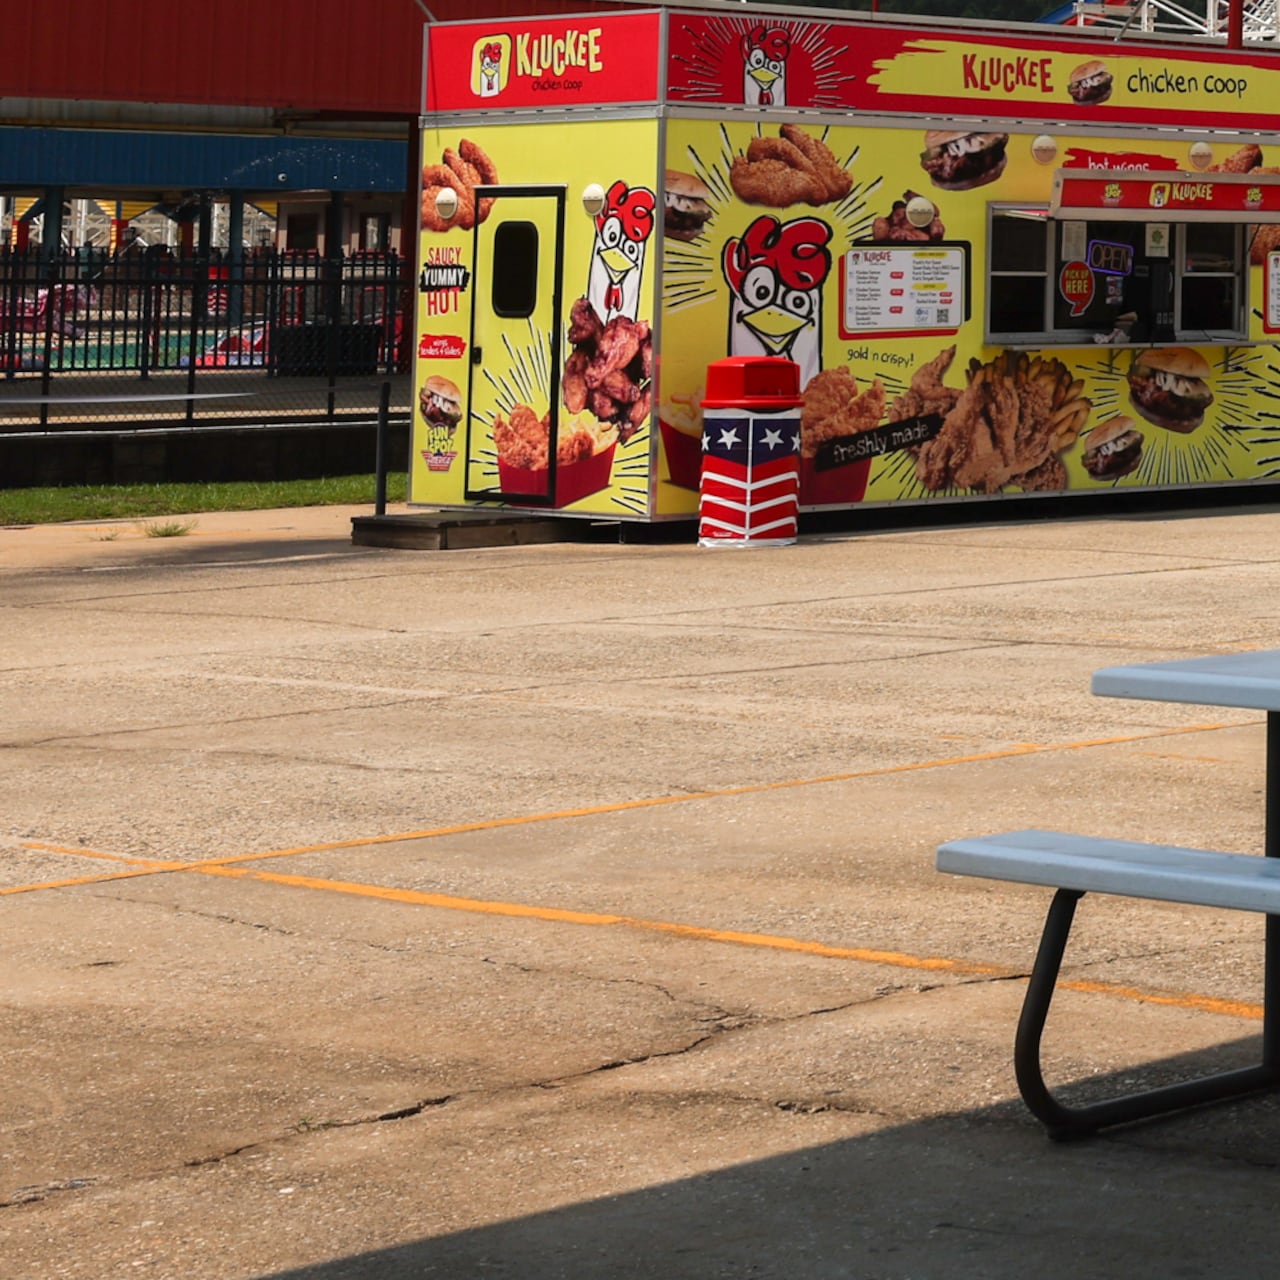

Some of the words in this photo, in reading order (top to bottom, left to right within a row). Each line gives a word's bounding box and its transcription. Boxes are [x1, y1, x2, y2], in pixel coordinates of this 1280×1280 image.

[516, 28, 603, 77] KLUCKEE
[962, 54, 1054, 93] KLUCKEE
[1127, 67, 1198, 94] chicken
[1203, 74, 1248, 99] coop
[1172, 183, 1213, 201] KLUCKEE
[428, 246, 462, 266] SAUCY
[1091, 243, 1131, 273] OPEN
[424, 268, 465, 287] YUMMY
[1065, 270, 1079, 279] PICK
[1081, 269, 1089, 279] UP
[1065, 280, 1089, 294] HERE
[427, 286, 461, 316] HOT
[847, 346, 869, 361] gold
[872, 352, 879, 360] n
[880, 352, 915, 368] crispy!
[428, 425, 449, 444] FUN
[833, 431, 887, 463] freshly
[892, 420, 929, 446] made
[428, 438, 454, 455] SPOT
